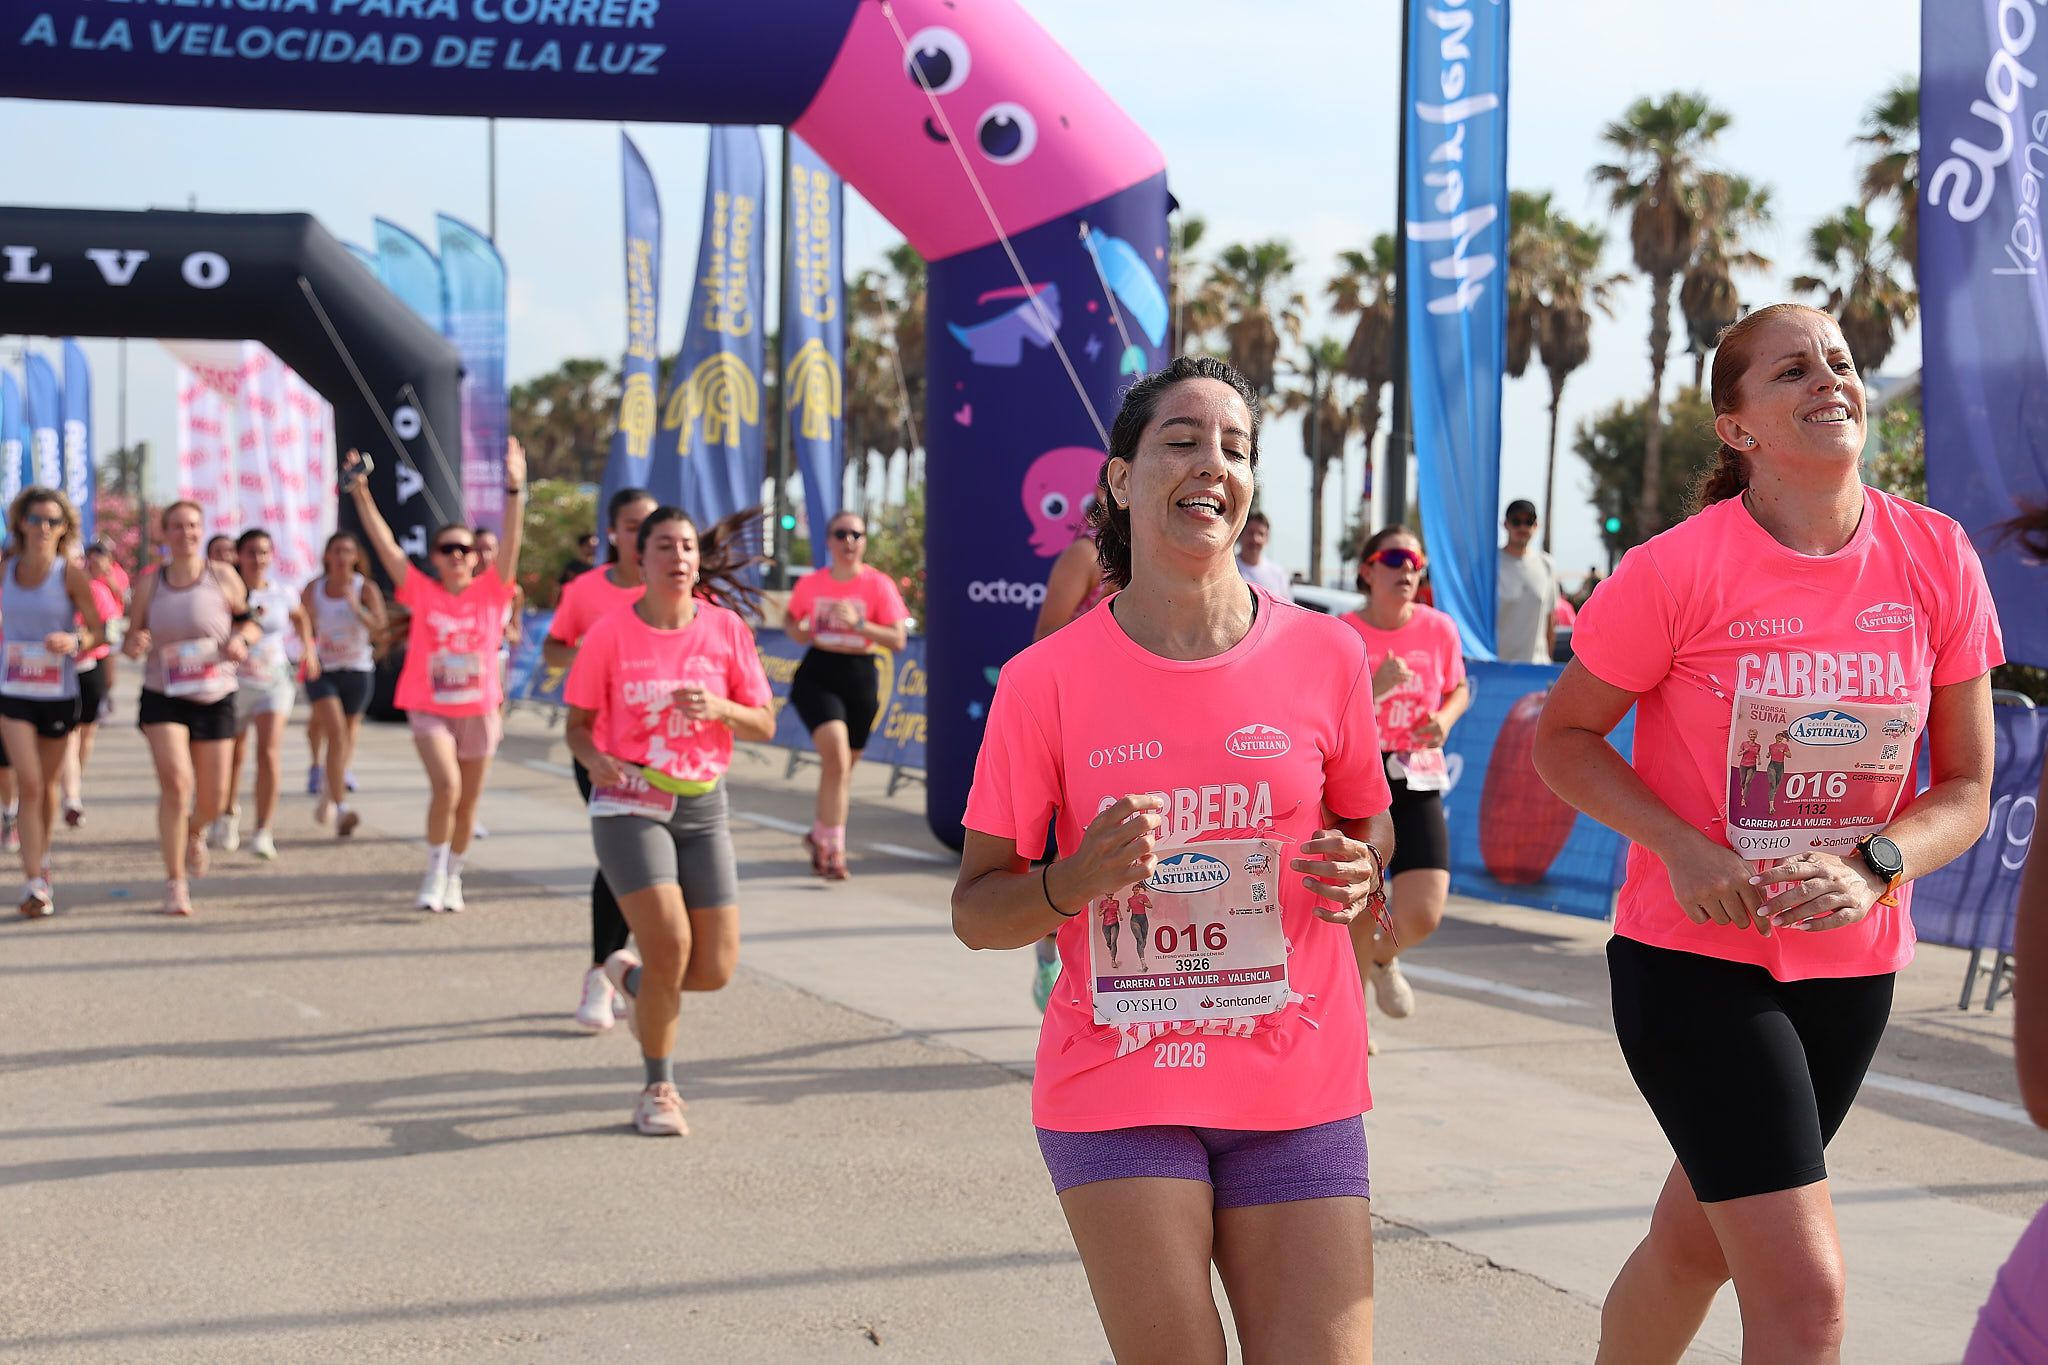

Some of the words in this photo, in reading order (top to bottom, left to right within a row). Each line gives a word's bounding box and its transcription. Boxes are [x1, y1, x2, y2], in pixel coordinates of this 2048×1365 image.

[470, 0, 663, 29] CORRER
[20, 13, 58, 46] A
[69, 16, 133, 51] LA
[149, 20, 423, 66] VELOCIDAD
[430, 36, 497, 70] DE
[503, 38, 563, 72] LA
[573, 42, 667, 76] LUZ
[1728, 617, 1804, 639] OYSHO
[1861, 613, 1913, 629] ASTURIANA
[1737, 651, 1909, 698] CARRERA
[1750, 703, 1759, 711] TU
[1760, 704, 1787, 714] DORSAL
[1750, 711, 1787, 724] SUMA
[1794, 722, 1860, 739] ASTURIANA
[1231, 737, 1287, 752] ASTURIANA
[1089, 740, 1163, 768] OYSHO
[1785, 772, 1848, 799] 016
[1798, 803, 1828, 815] 1132
[1739, 817, 1779, 829] CARRERA
[1780, 818, 1790, 828] DE
[1791, 818, 1802, 827] LA
[1804, 817, 1832, 827] MUJER
[1839, 816, 1874, 826] VALENCIA
[1738, 836, 1791, 850] OYSHO
[1150, 869, 1225, 886] ASTURIANA
[1154, 922, 1228, 954] 016
[1175, 957, 1210, 972] 3926
[1113, 979, 1156, 990] CARRERA
[1158, 977, 1171, 987] DE
[1173, 976, 1186, 986] LA
[1188, 973, 1220, 985] MUJER
[1227, 970, 1271, 983] VALENCIA
[1116, 997, 1178, 1013] OYSHO
[1215, 994, 1272, 1008] Santander
[1153, 1042, 1206, 1069] 2026
